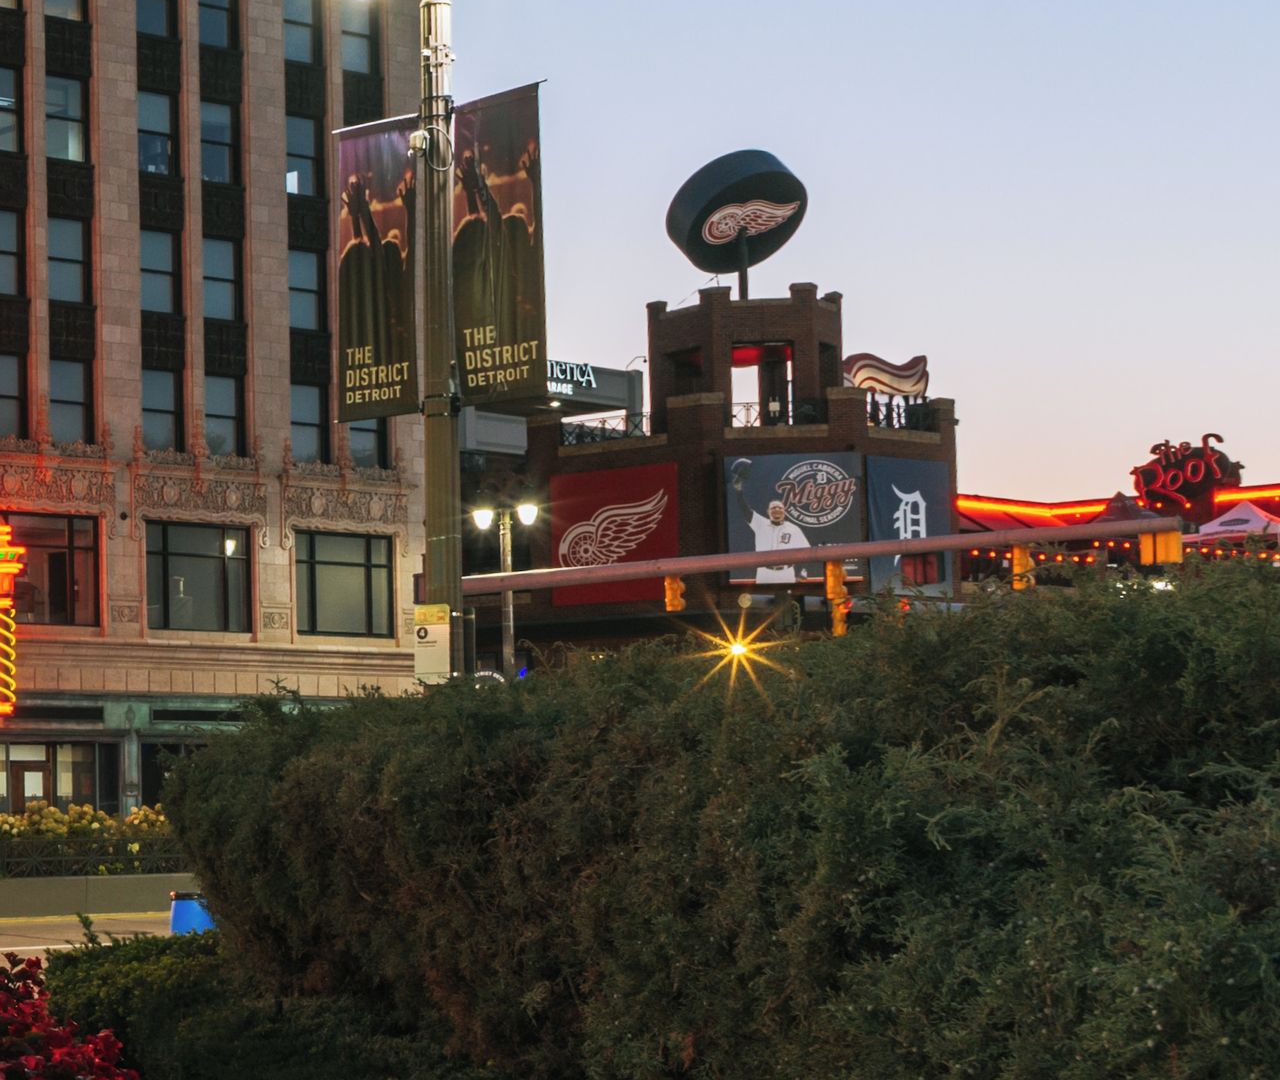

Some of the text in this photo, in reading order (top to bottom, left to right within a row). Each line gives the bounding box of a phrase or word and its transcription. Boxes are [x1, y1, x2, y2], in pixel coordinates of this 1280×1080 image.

[463, 325, 496, 347] THE
[346, 346, 372, 366] THE
[465, 340, 539, 370] DISTRICT
[346, 362, 410, 388] DISTRICT
[467, 366, 529, 387] DETROIT
[346, 386, 402, 404] DETROIT
[547, 381, 574, 395] ARAGE
[776, 478, 856, 512] Miggy
